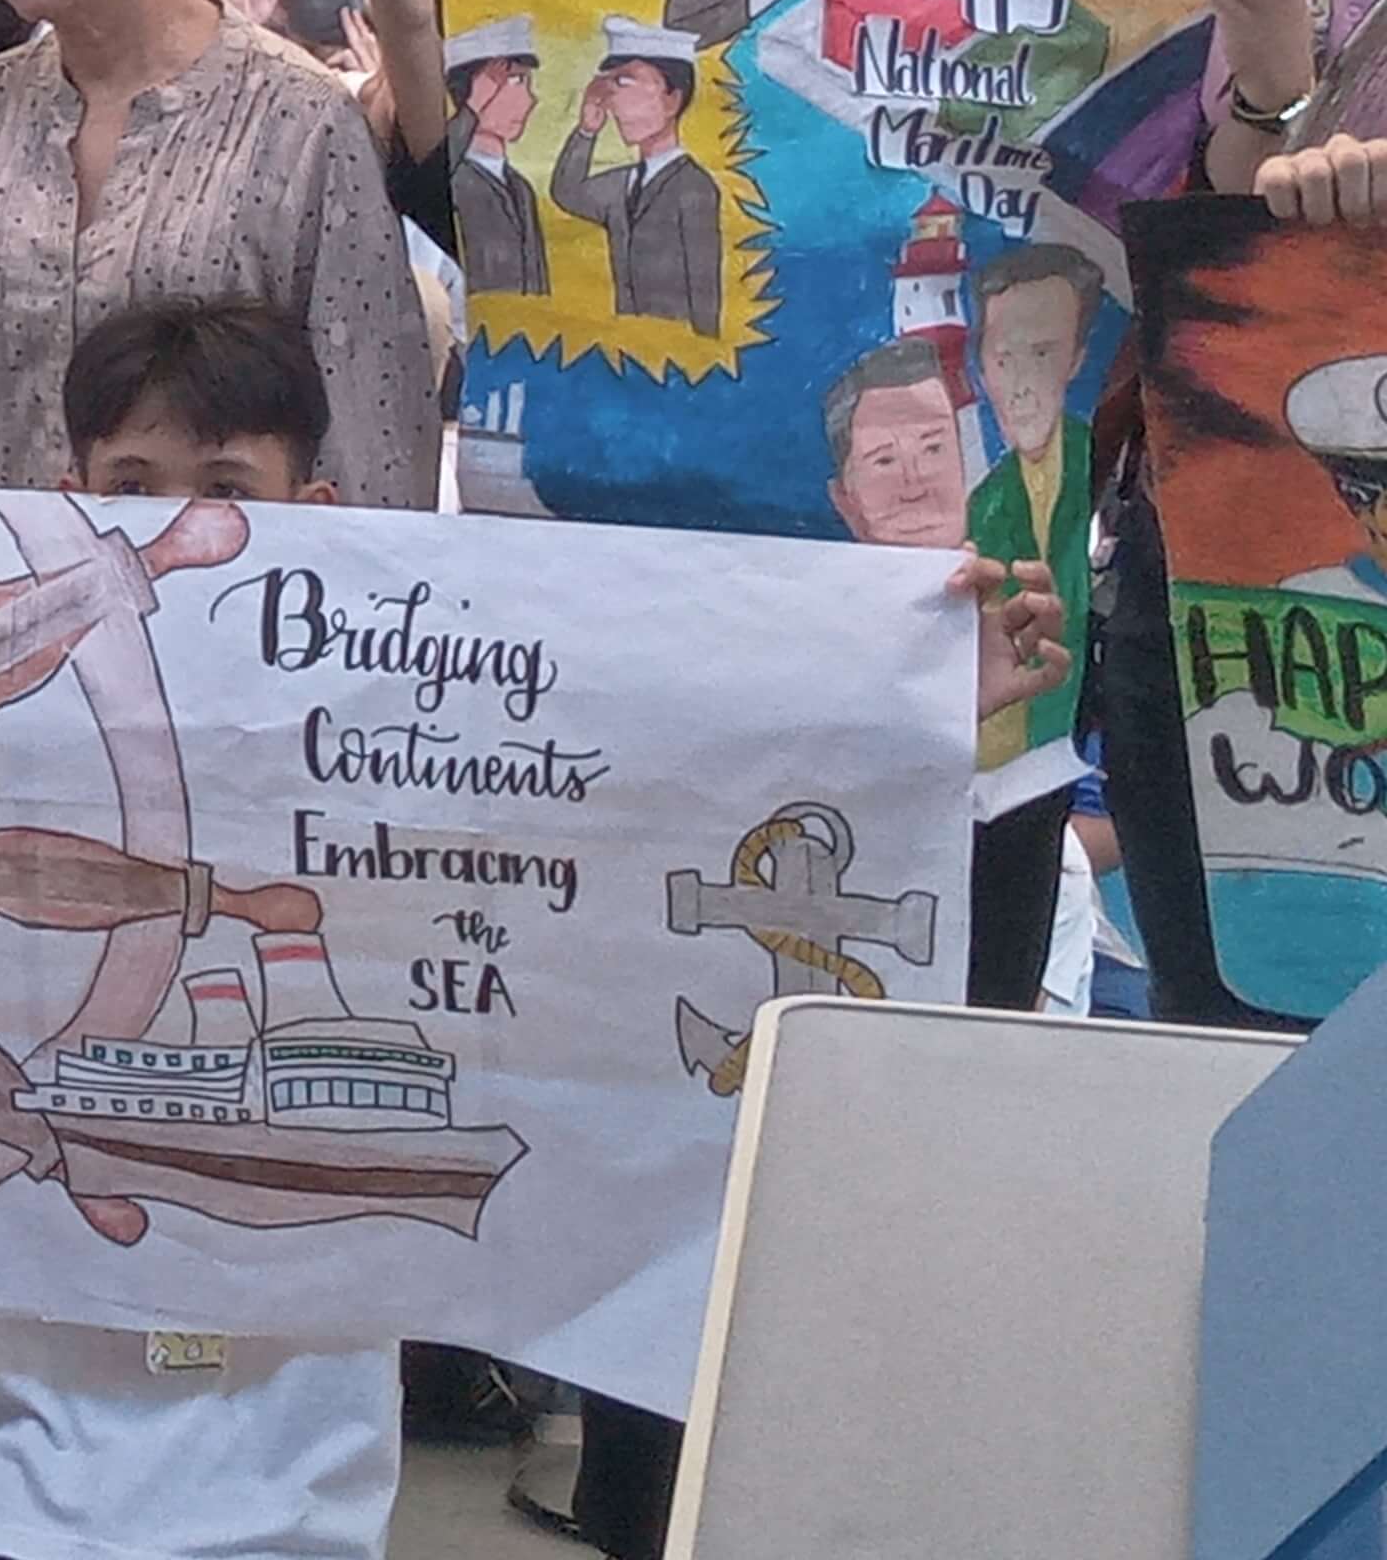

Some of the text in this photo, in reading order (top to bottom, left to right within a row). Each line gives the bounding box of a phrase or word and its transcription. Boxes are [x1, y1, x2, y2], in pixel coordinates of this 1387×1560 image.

[853, 18, 1037, 104] National
[960, 170, 1042, 237] Day
[210, 566, 558, 723] Bridging
[303, 705, 611, 803] Continents
[293, 809, 578, 913] Embracing
[432, 909, 512, 954] the
[408, 957, 518, 1019] SEA
